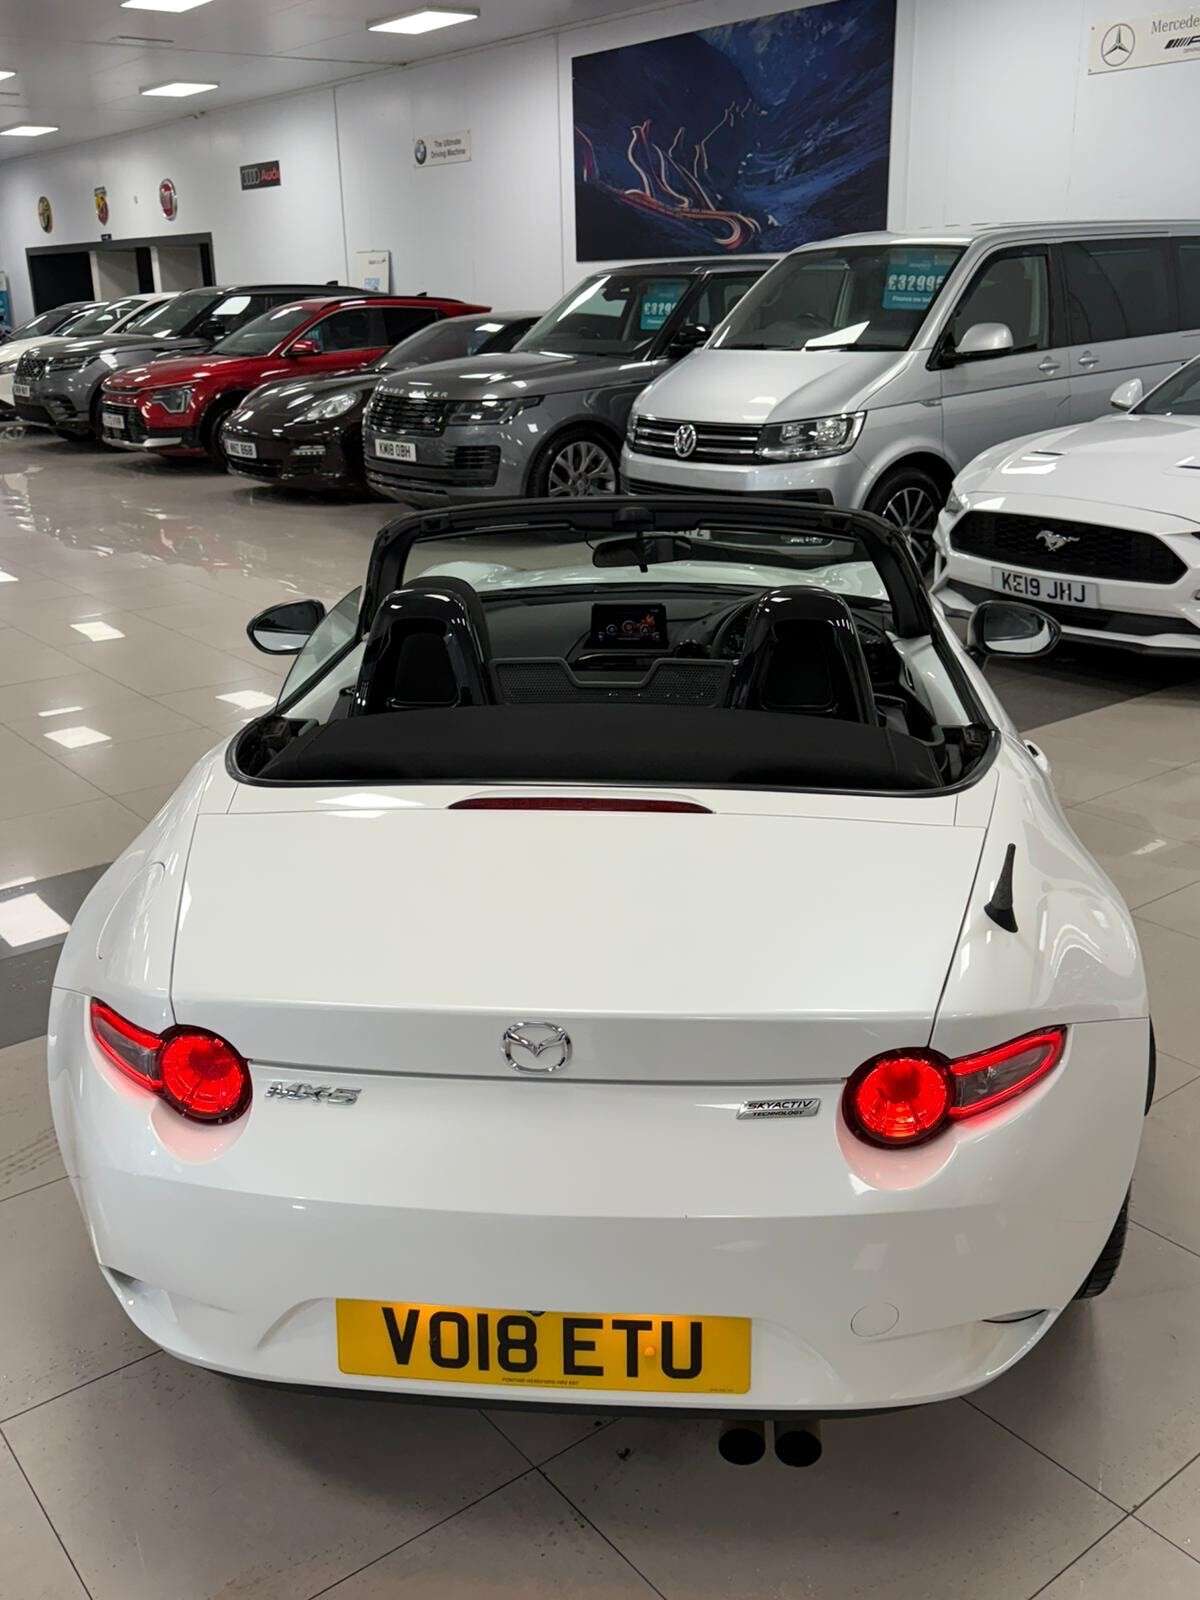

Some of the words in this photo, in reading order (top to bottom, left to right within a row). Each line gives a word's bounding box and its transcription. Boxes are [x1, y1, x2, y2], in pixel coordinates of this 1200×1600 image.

[261, 167, 280, 181] Audi
[1002, 572, 1040, 596] KE19
[1047, 582, 1085, 603] JHJ
[748, 1101, 813, 1110] SKYACTIV
[382, 1307, 538, 1373] VO18
[563, 1318, 703, 1379] ETU
